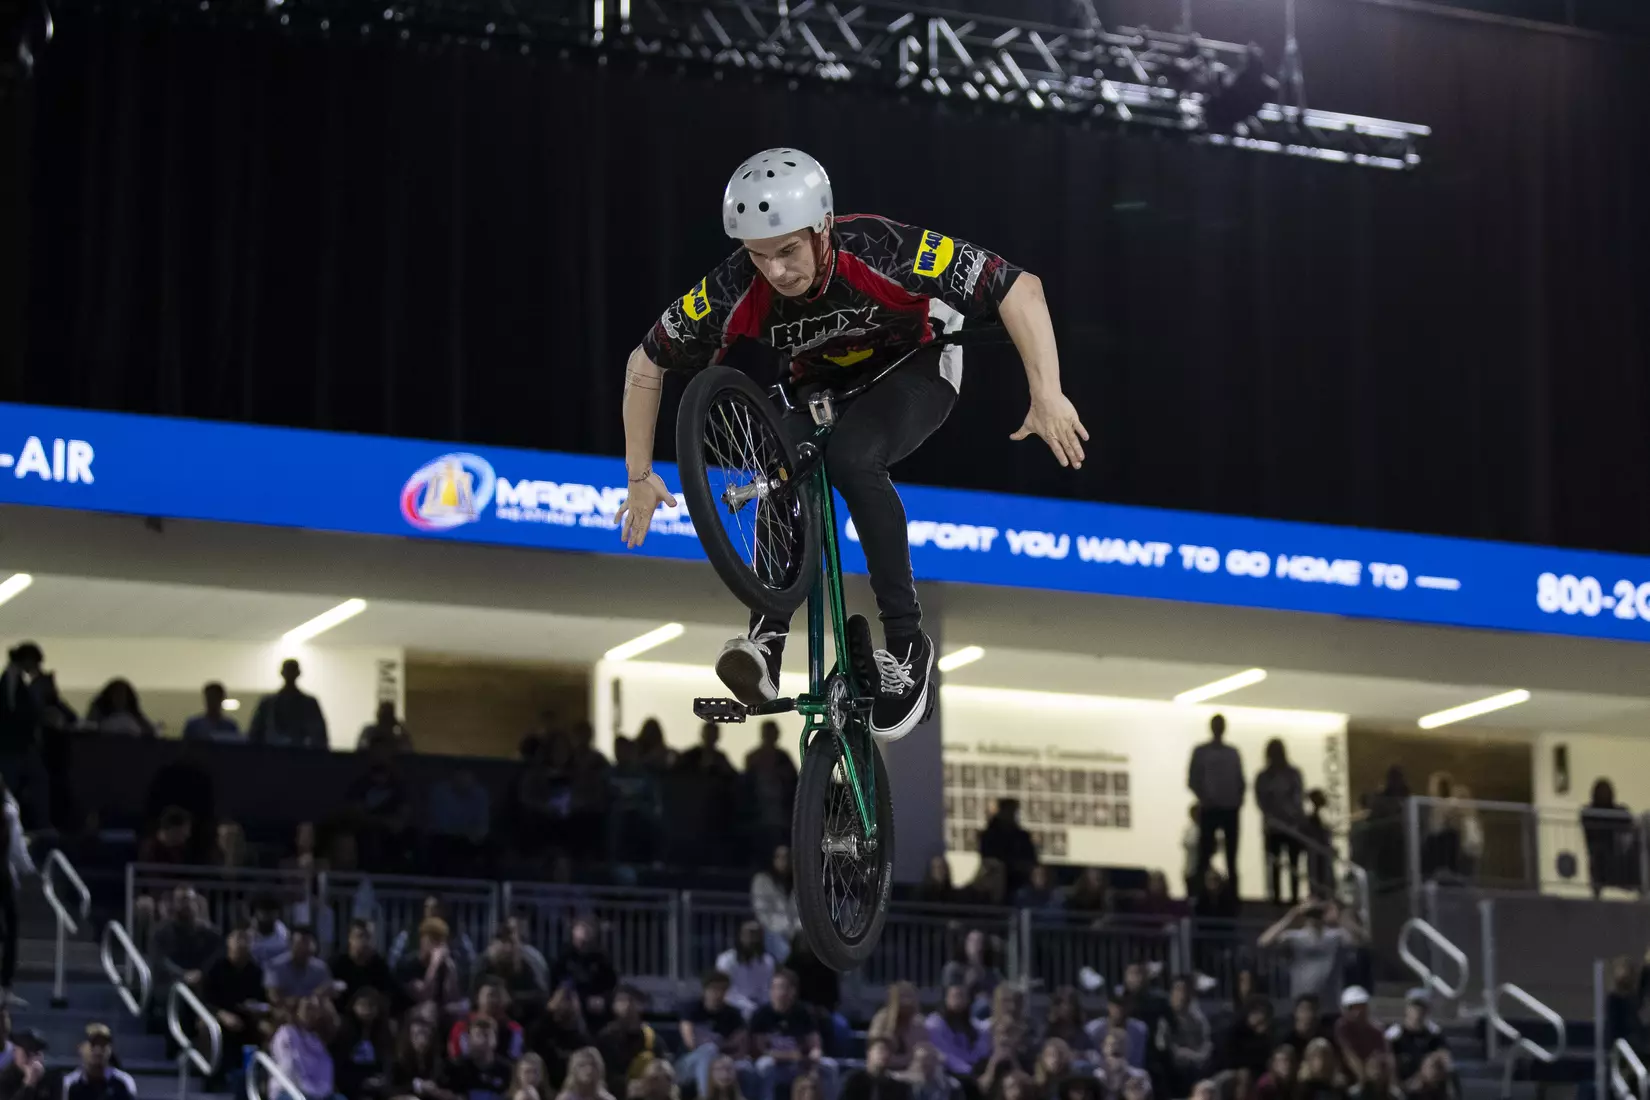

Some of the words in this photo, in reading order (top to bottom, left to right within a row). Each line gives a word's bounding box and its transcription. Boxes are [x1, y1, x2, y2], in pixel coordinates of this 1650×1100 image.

[917, 231, 944, 272] WD-40
[771, 306, 881, 350] BMX
[496, 477, 690, 521] MAGN
[845, 516, 998, 552] FORT
[1006, 529, 1070, 559] YOU
[1077, 536, 1172, 567] WANT
[1179, 544, 1220, 573] TO
[1225, 549, 1271, 577] GO
[1275, 554, 1362, 587] HOME
[1369, 562, 1408, 590] TO
